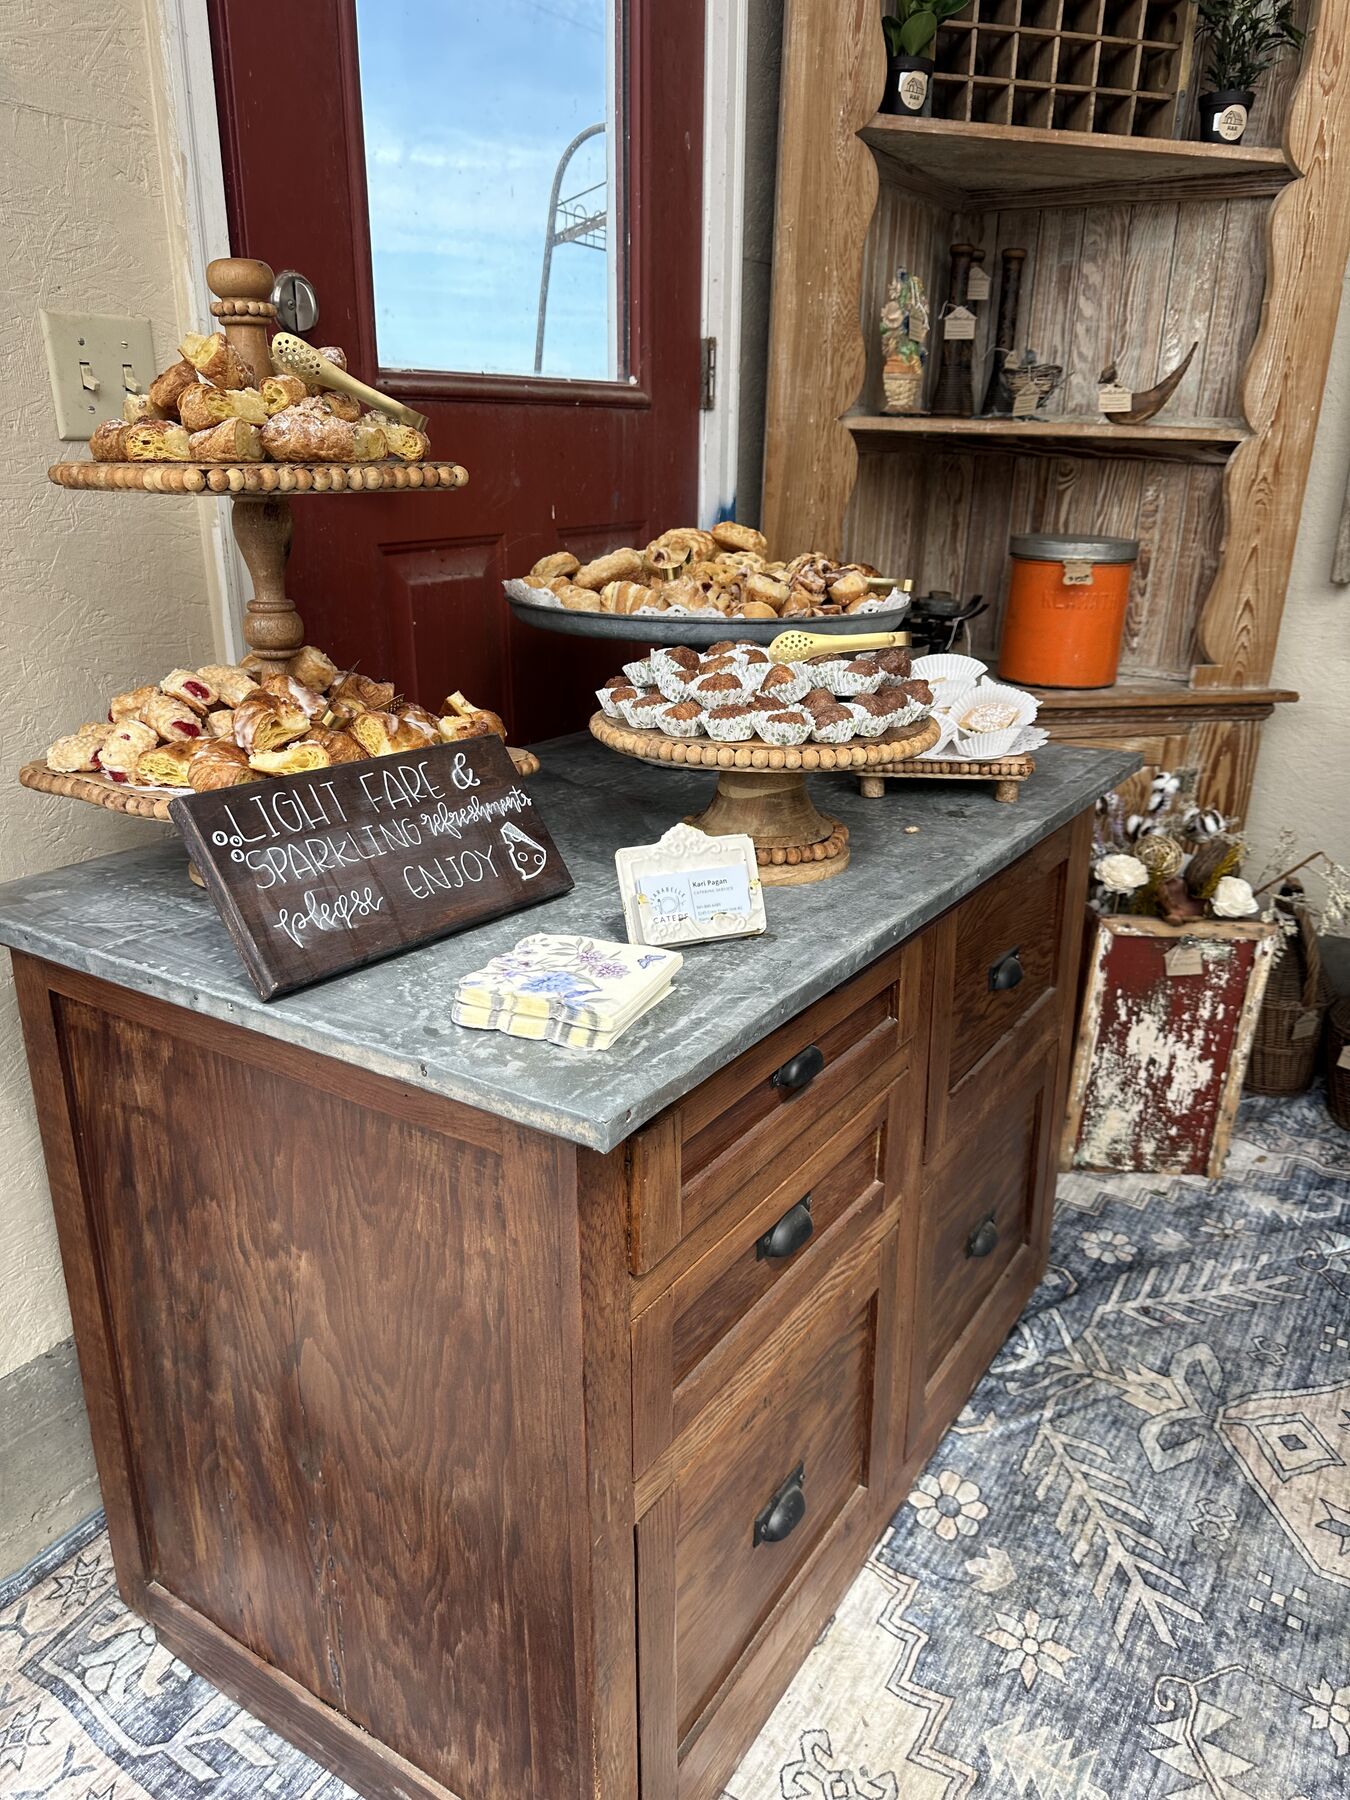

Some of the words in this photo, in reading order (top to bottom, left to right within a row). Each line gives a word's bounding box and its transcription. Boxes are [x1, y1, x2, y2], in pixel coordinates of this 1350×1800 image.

[224, 780, 347, 843] LIGHT
[359, 761, 446, 814] FARE
[450, 752, 481, 790] &
[244, 817, 422, 890] SPARKLING
[420, 785, 532, 840] refreshments
[273, 884, 384, 949] please
[402, 845, 501, 900] ENJOY
[707, 879, 728, 887] Pagan
